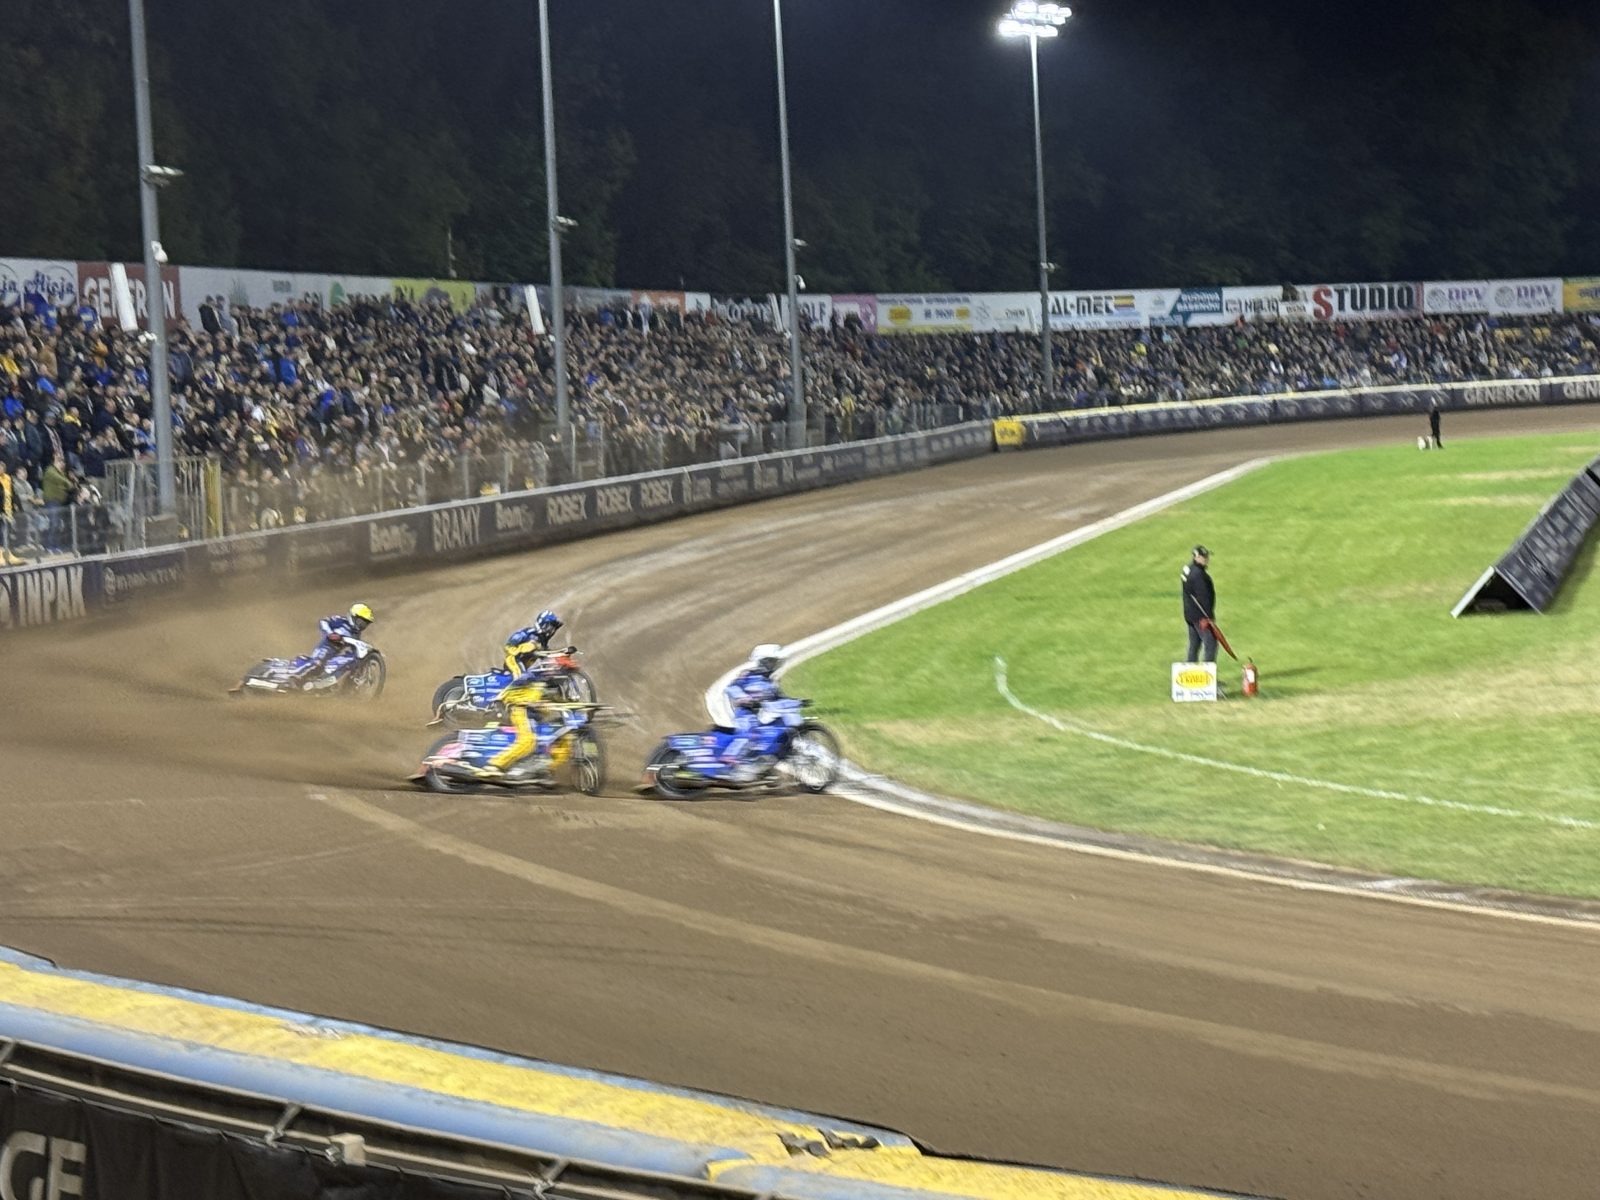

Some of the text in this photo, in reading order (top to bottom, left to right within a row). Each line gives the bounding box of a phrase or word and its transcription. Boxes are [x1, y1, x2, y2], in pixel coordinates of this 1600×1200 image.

[1312, 284, 1414, 320] STUDIO
[1464, 384, 1541, 405] GENERON
[432, 504, 480, 552] BRAMY
